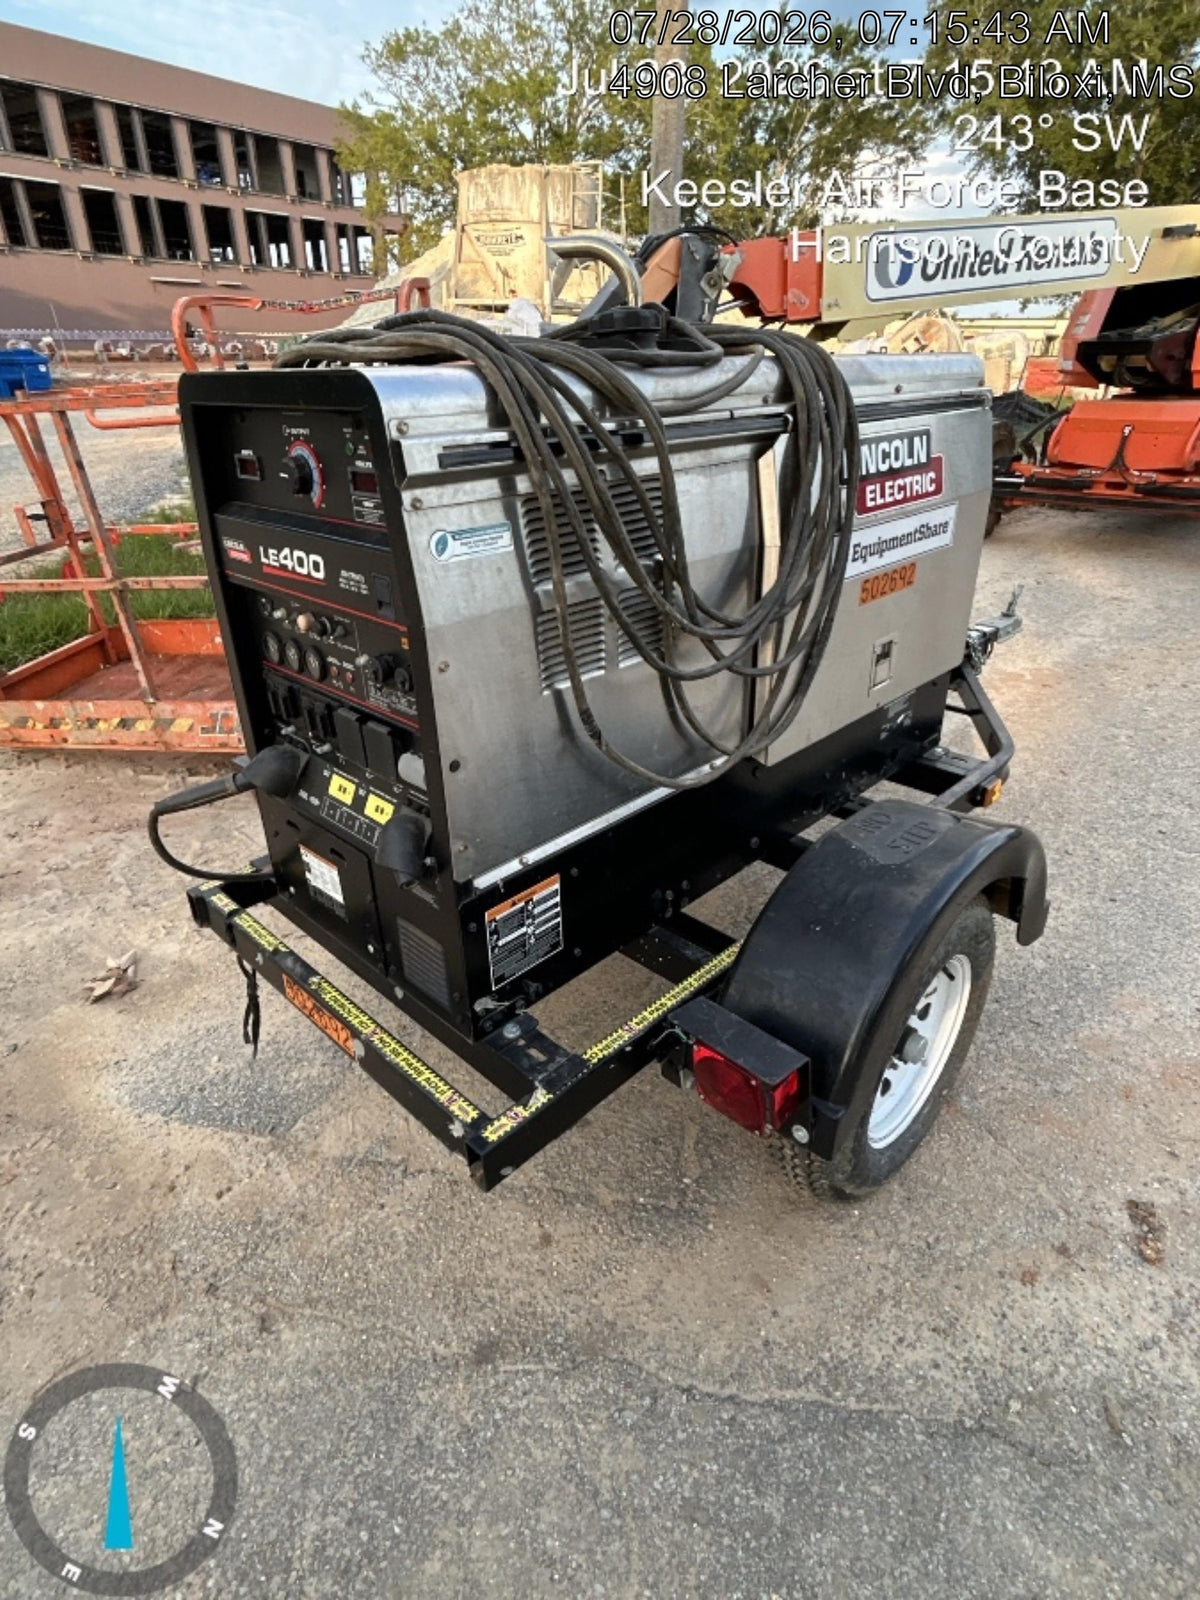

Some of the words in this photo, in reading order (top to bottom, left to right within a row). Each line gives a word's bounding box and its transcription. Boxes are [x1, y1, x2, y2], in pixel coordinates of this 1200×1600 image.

[920, 236, 1014, 282] United
[865, 470, 937, 508] ELECTRIC
[258, 544, 325, 580] LE400
[851, 519, 949, 563] EquipmentShare
[860, 562, 916, 604] 502692
